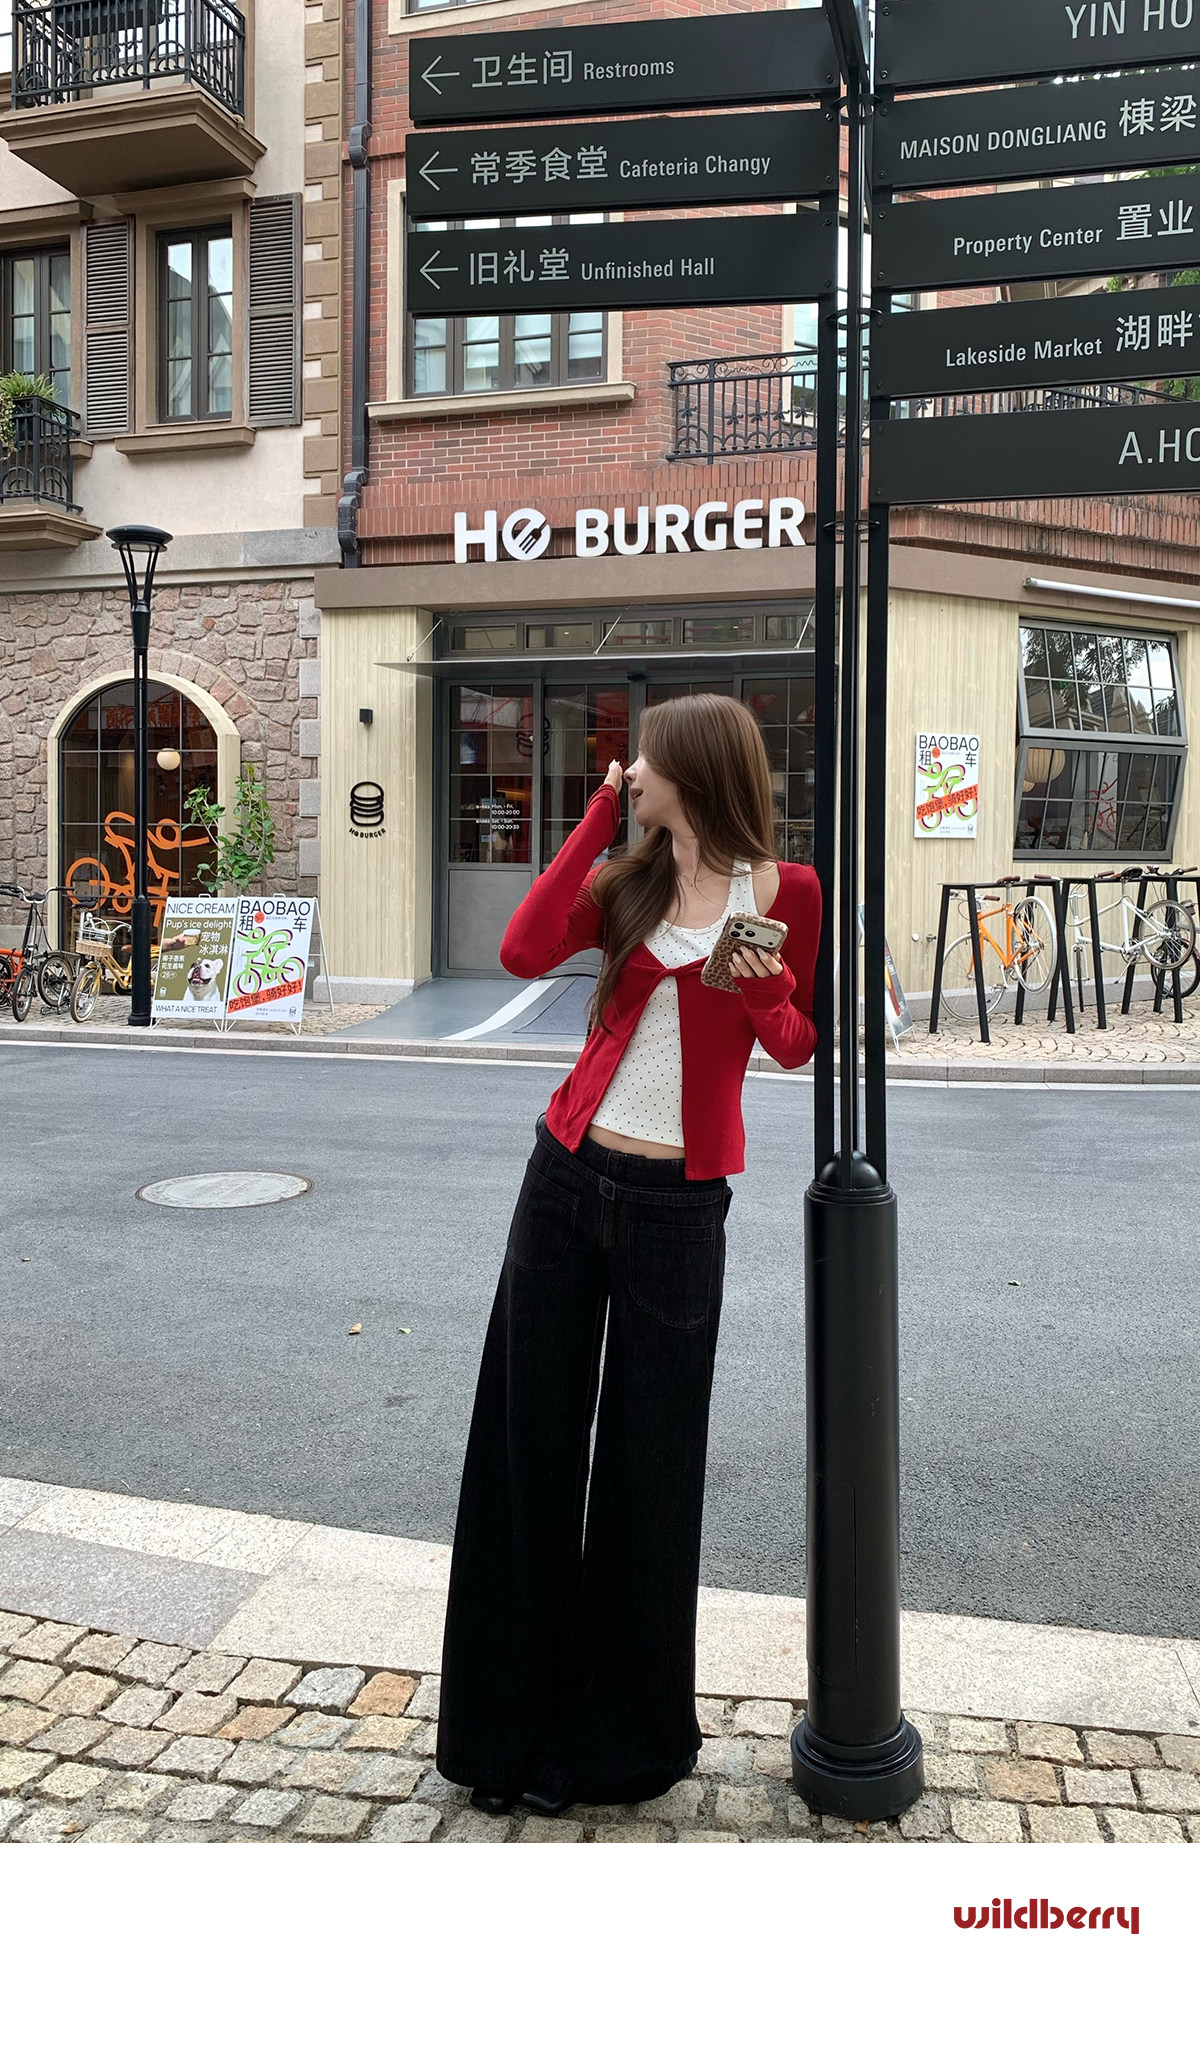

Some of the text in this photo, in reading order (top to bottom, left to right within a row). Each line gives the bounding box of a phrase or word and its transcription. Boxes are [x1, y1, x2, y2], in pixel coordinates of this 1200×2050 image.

[1065, 0, 1126, 39] YIN
[471, 50, 675, 88] 卫生间 Restrooms
[900, 94, 1197, 160] MAISON DONGLIANG 棟梁
[470, 145, 771, 186] 常季食堂 Cafeteria Changy
[953, 200, 1194, 257] Property Center 置业
[469, 247, 715, 286] 旧礼堂 Unfinished Hall
[945, 310, 1200, 367] Lakeside Market 湖畔
[575, 496, 806, 558] BURGER
[919, 734, 980, 752] BAOBAO
[919, 750, 977, 768] 租 车
[167, 902, 235, 914] NICE CREAM
[240, 900, 311, 916] BAOBAO
[189, 919, 202, 929] ice
[203, 920, 232, 931] delight
[239, 915, 254, 931] 租
[292, 916, 308, 933] 车
[201, 931, 221, 942] 宠物
[199, 944, 229, 955] 冰淇淋
[181, 1005, 197, 1013] NICE
